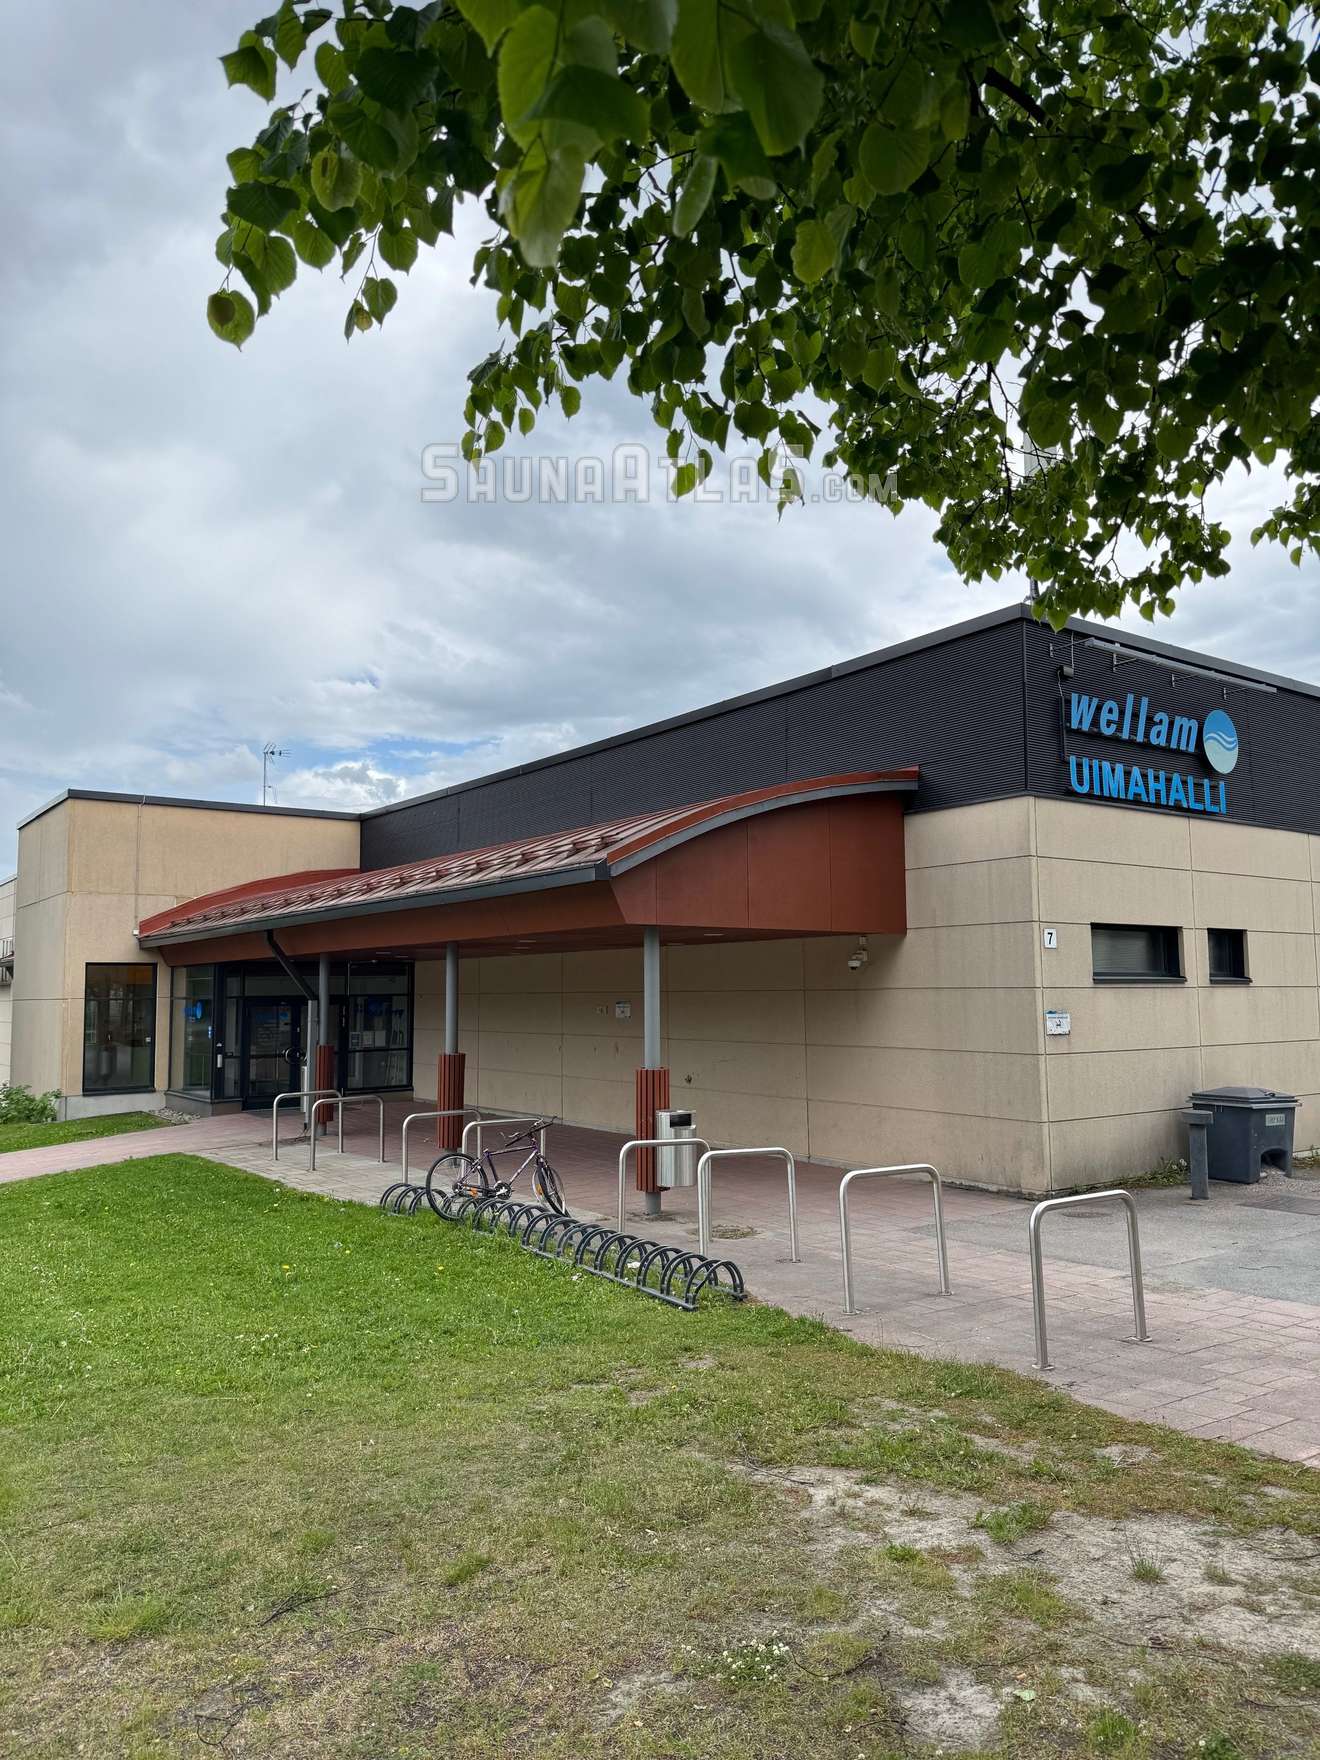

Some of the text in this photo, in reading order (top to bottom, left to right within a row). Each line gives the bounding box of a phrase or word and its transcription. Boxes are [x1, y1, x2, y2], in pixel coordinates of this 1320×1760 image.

[1070, 692, 1199, 753] wellam
[1069, 755, 1227, 815] UIMAHALLI
[1047, 931, 1054, 945] 7
